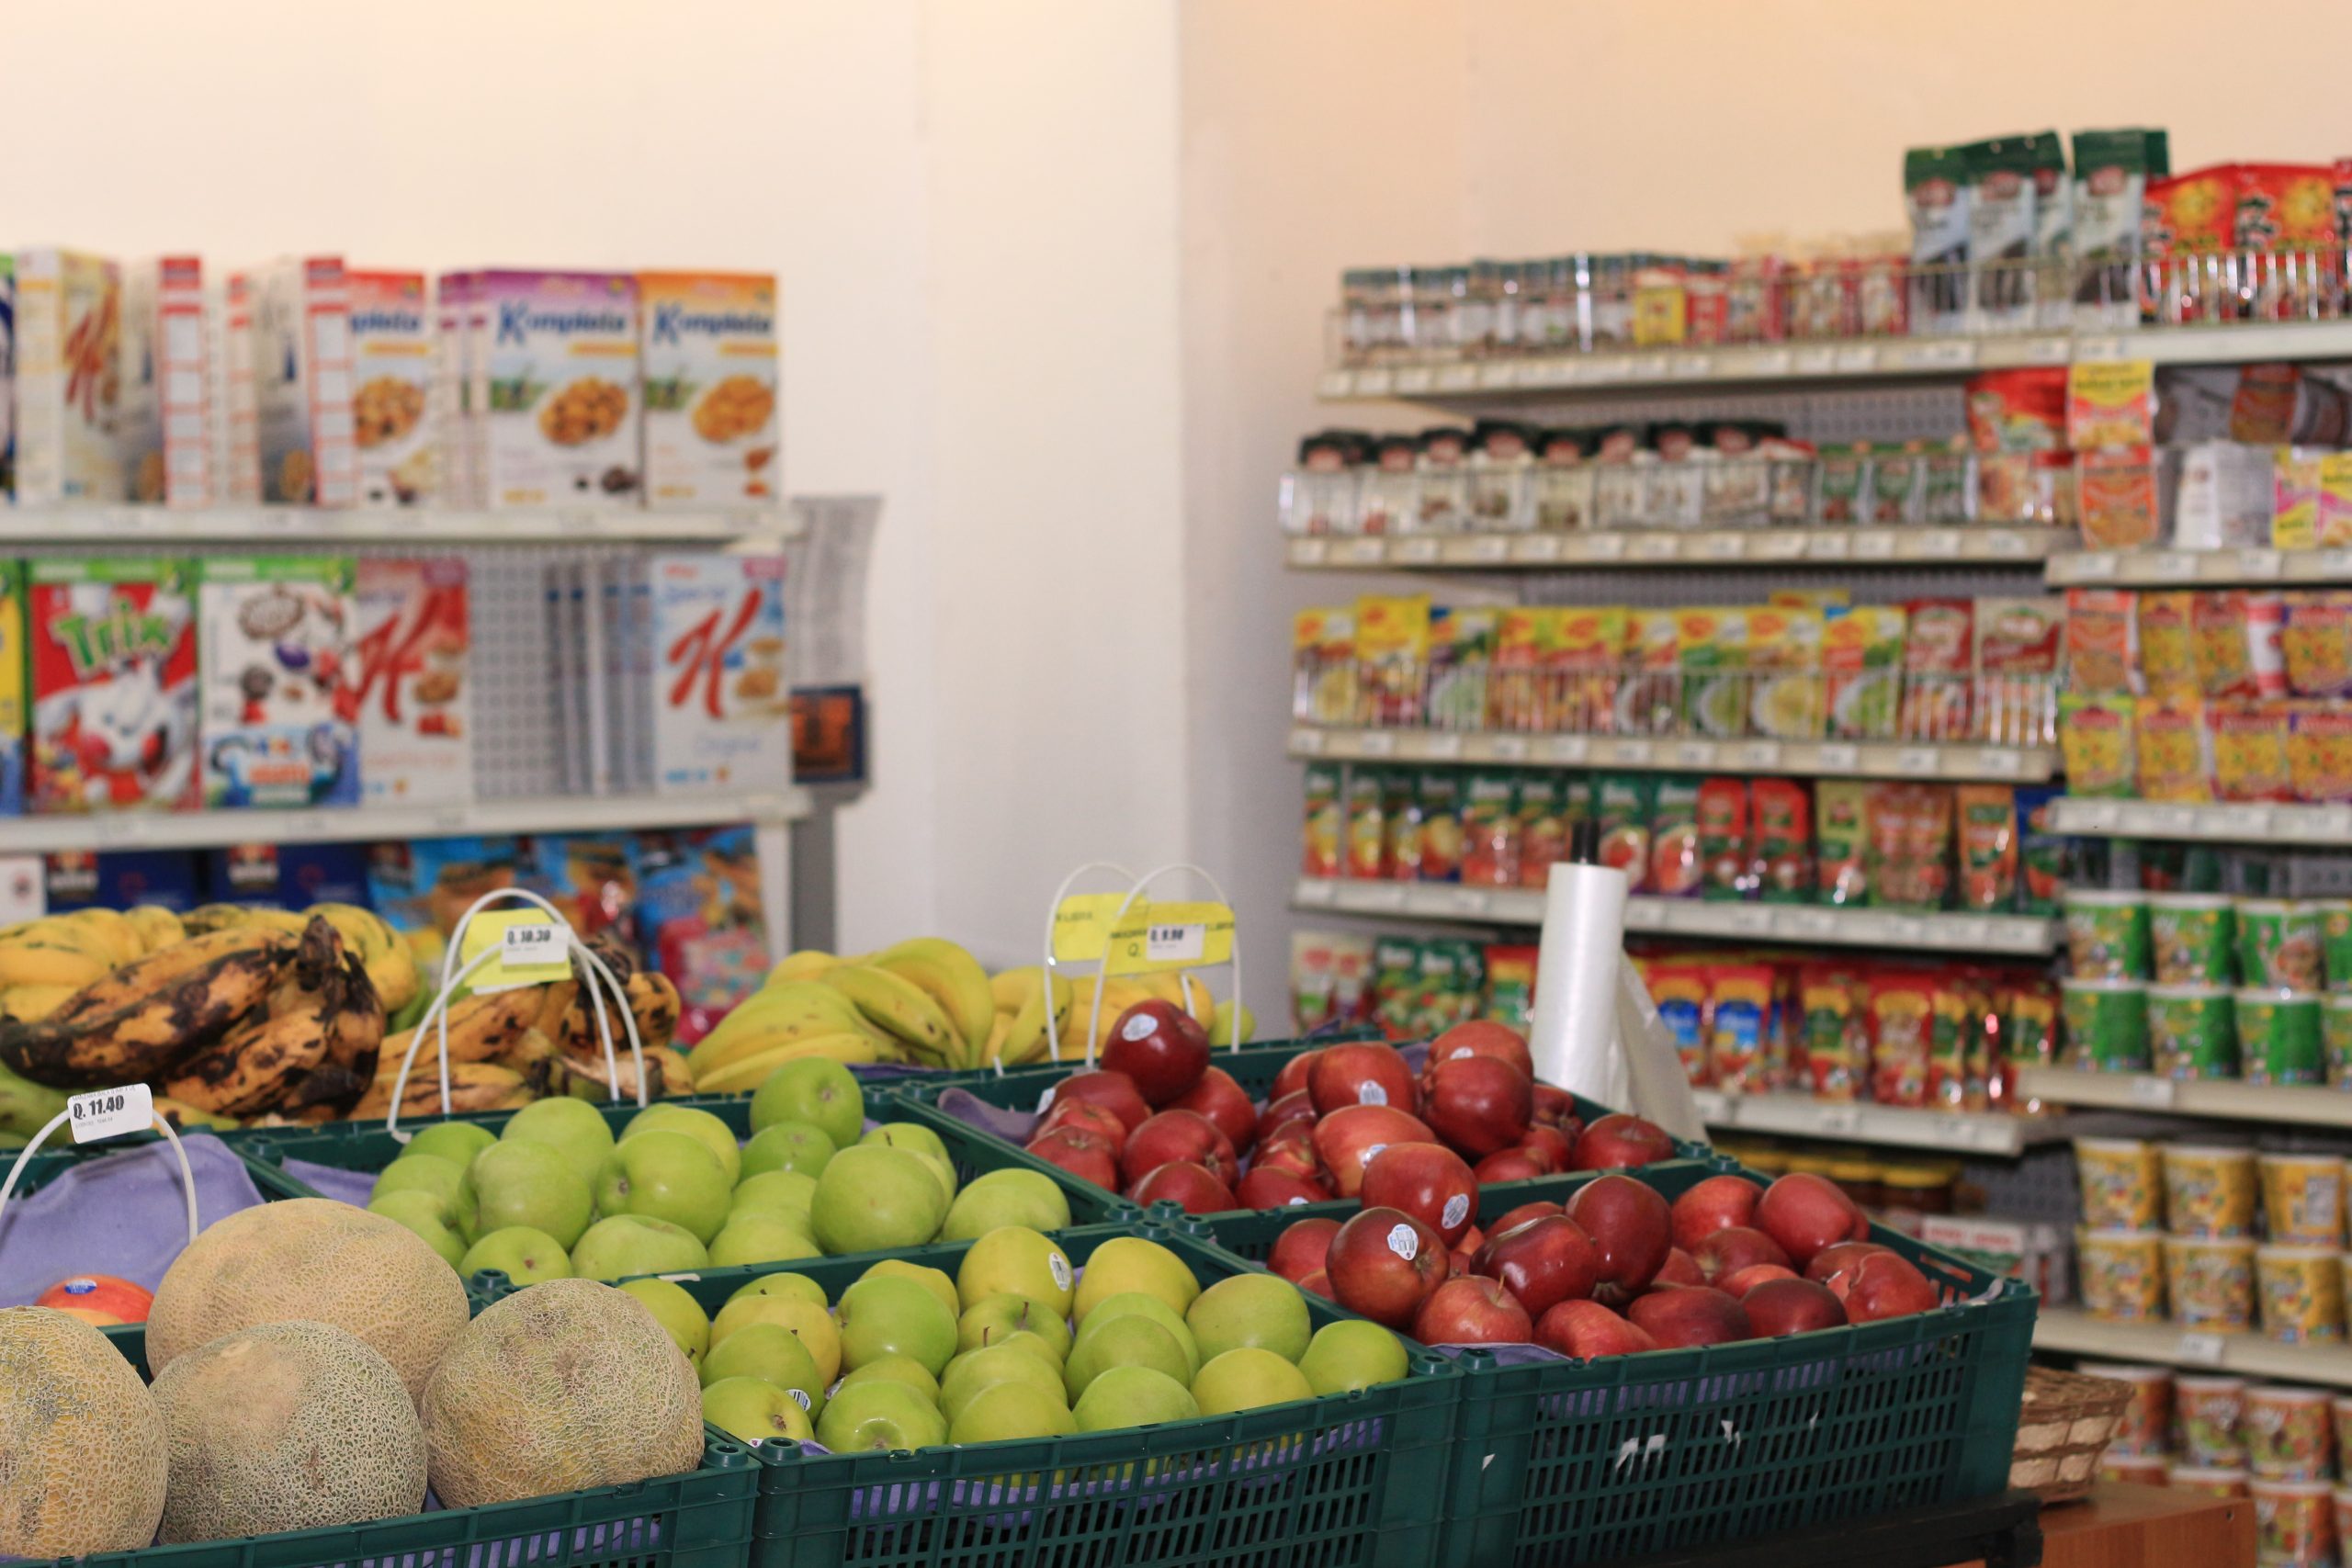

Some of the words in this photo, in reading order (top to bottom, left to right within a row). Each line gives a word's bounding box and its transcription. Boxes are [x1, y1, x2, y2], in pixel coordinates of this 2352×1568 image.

[52, 597, 173, 673] Trix
[666, 587, 763, 719] K
[73, 1103, 86, 1120] Q.
[89, 1095, 125, 1116] 11.40
